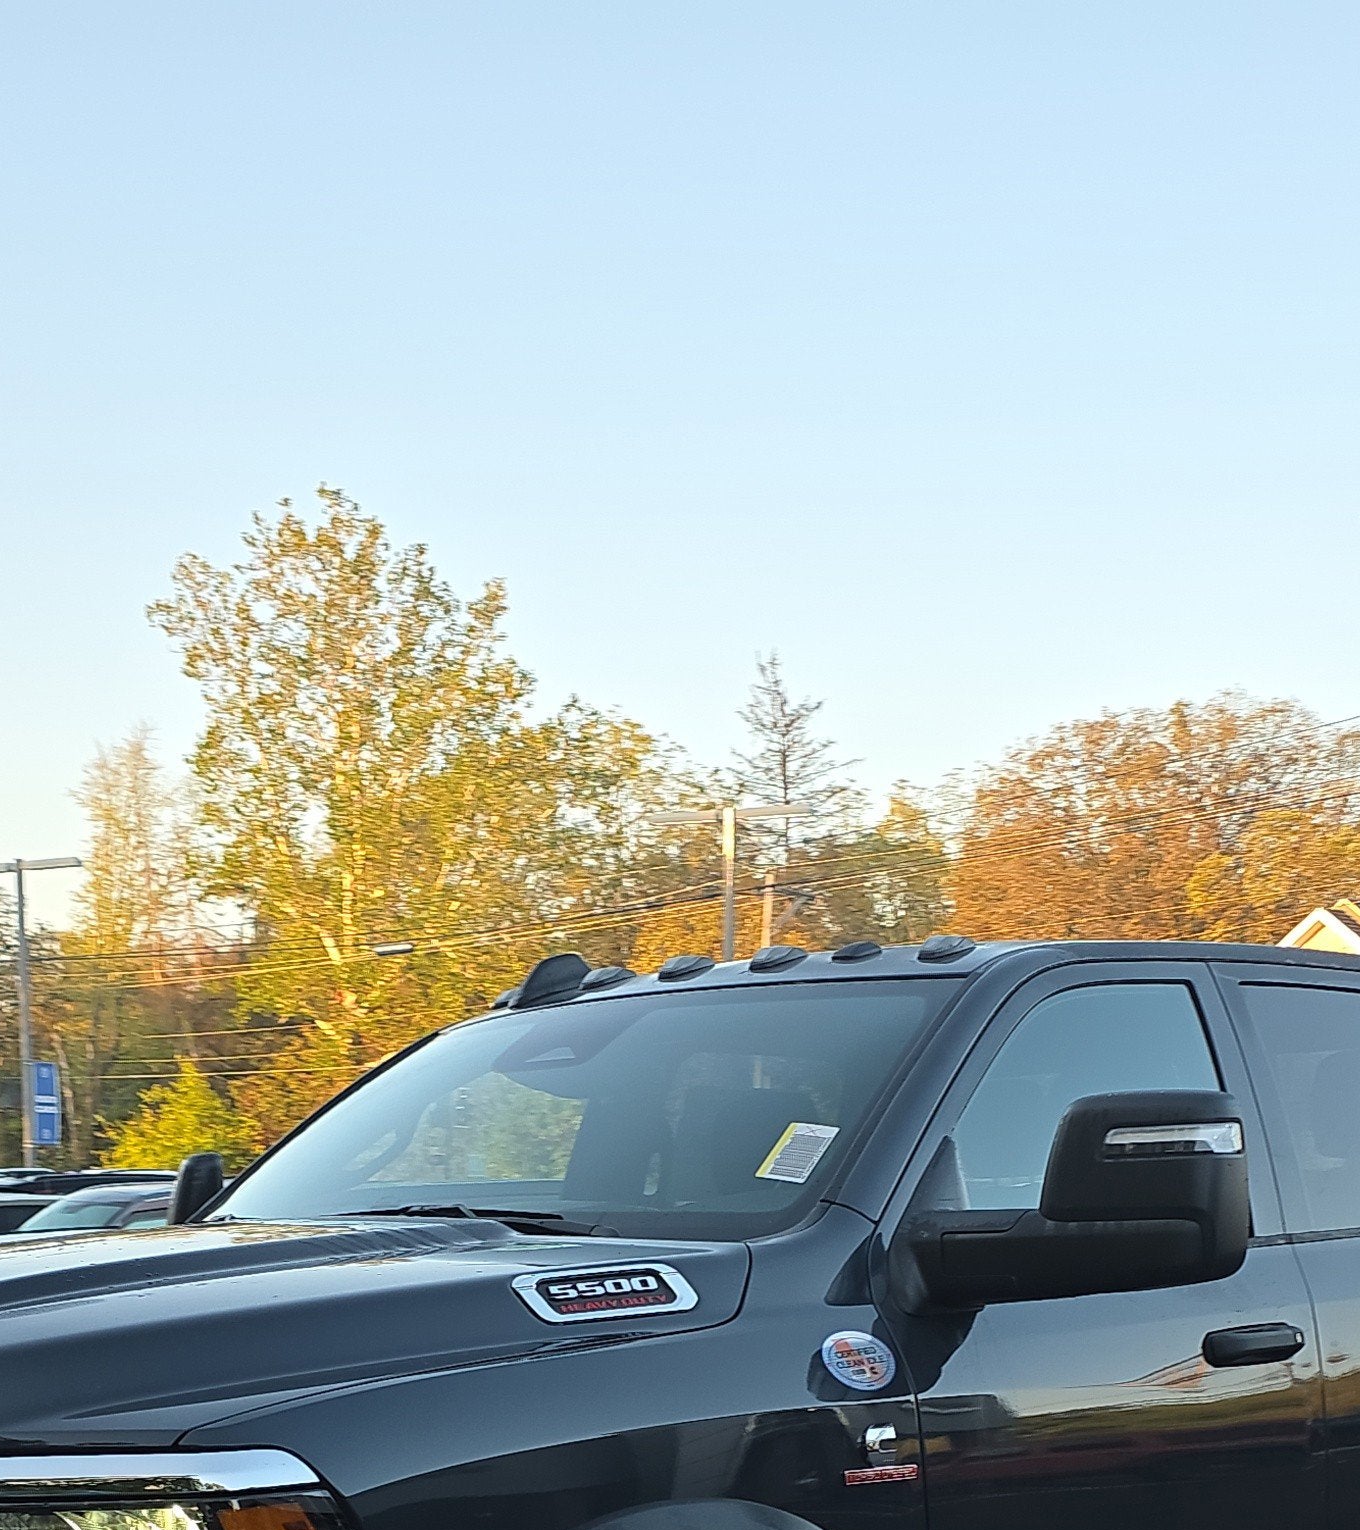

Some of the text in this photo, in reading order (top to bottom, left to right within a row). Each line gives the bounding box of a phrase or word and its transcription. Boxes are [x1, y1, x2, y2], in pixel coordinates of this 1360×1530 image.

[548, 1275, 659, 1300] 5500
[560, 1295, 668, 1313] HEAVY DUTY
